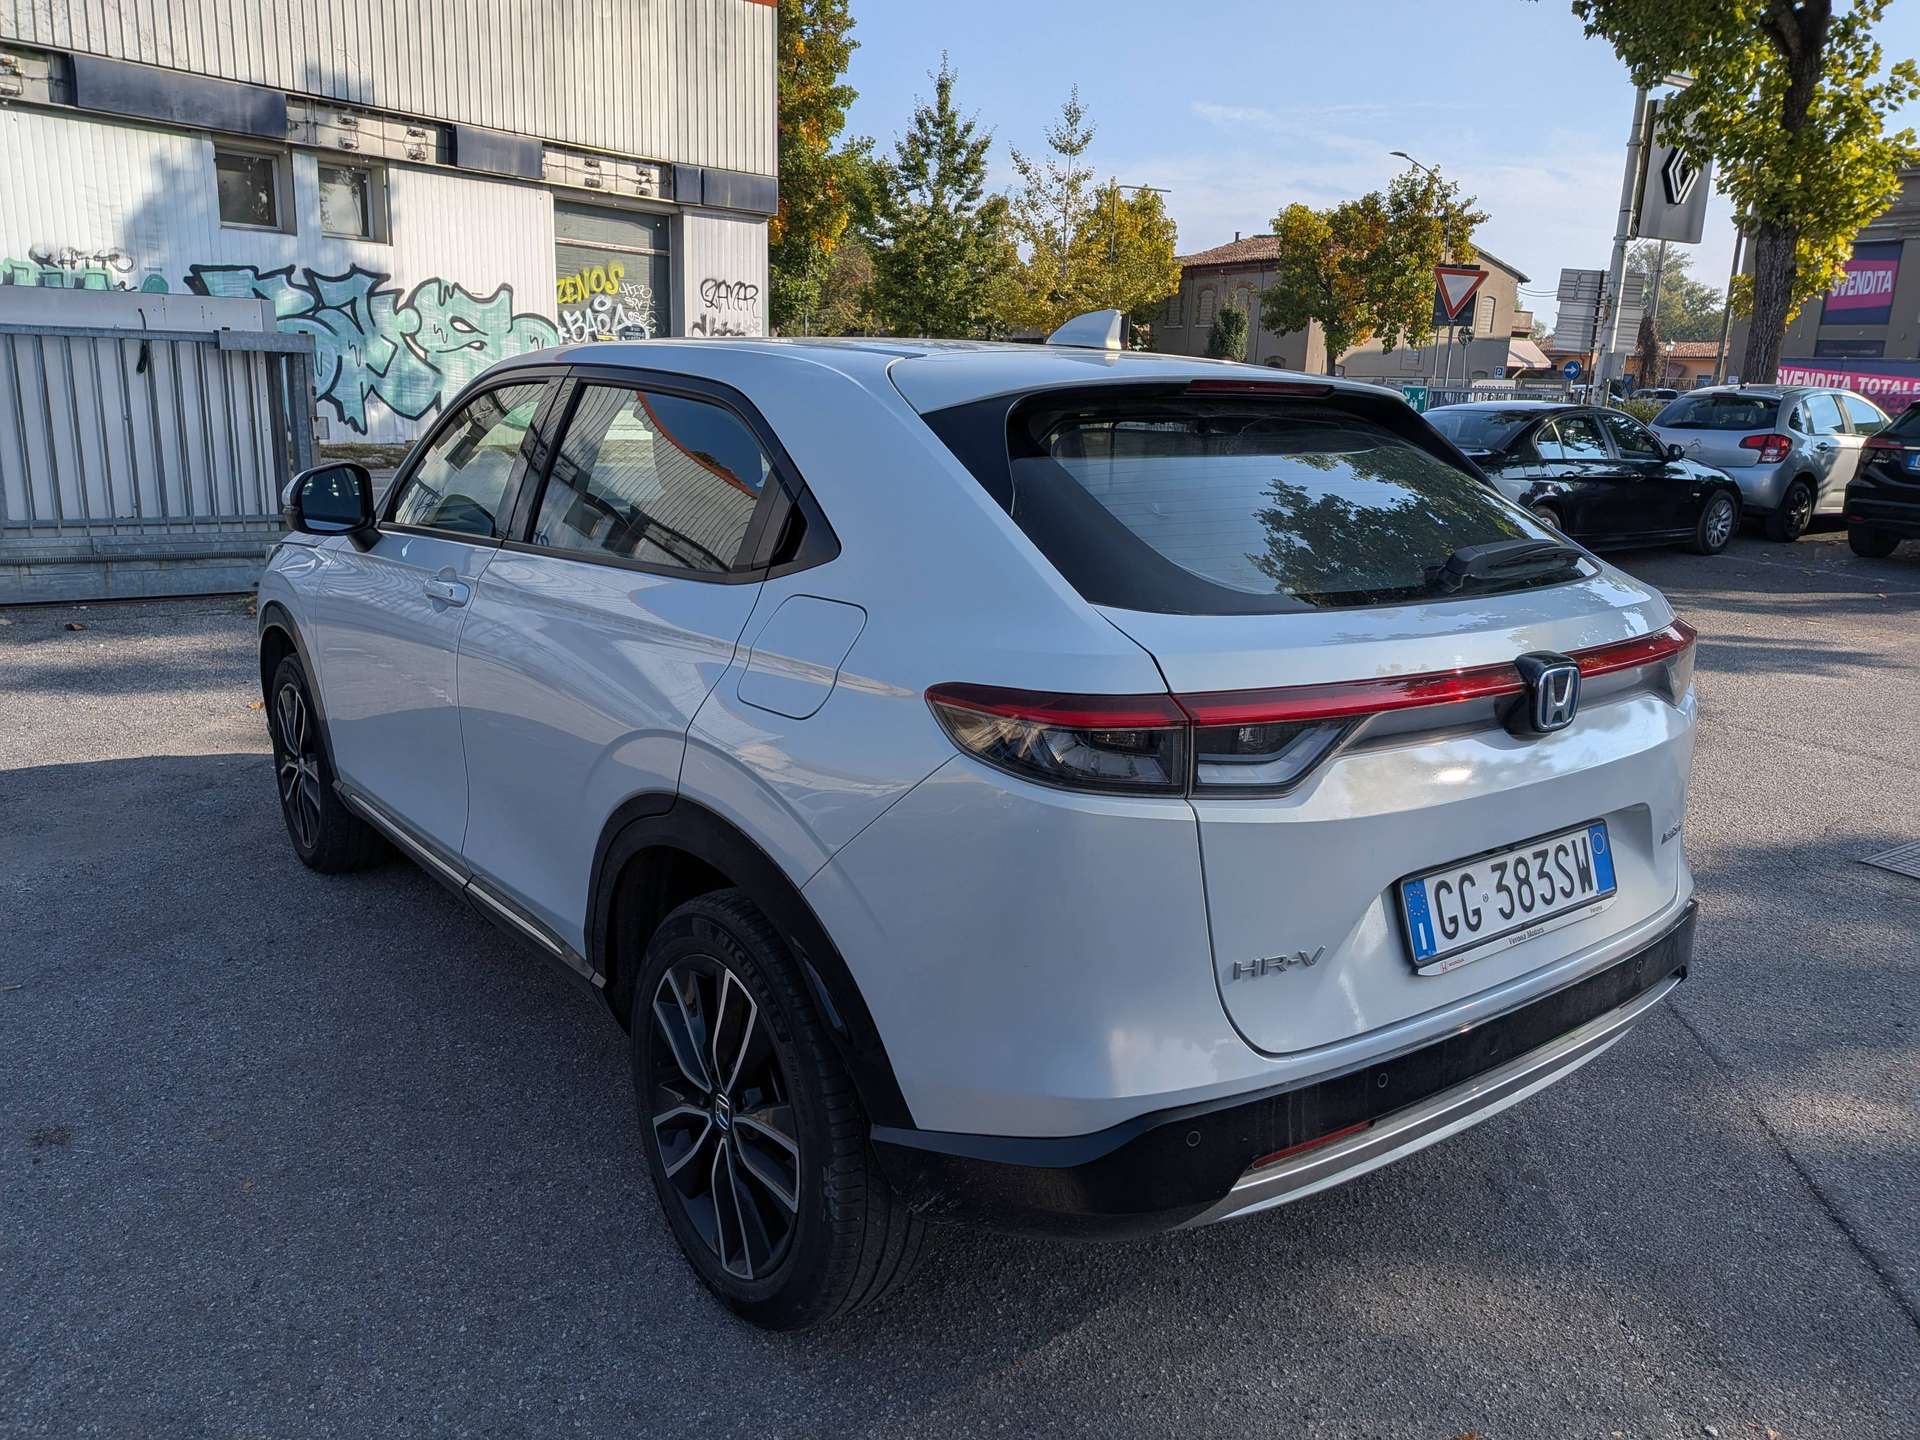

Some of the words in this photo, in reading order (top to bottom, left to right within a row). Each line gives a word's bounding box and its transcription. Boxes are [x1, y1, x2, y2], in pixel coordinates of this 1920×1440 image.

[557, 260, 625, 304] ZENOS
[1831, 270, 1893, 297] SVENDITA
[1857, 376, 1920, 395] TOTALE
[1233, 945, 1326, 980] HR-V
